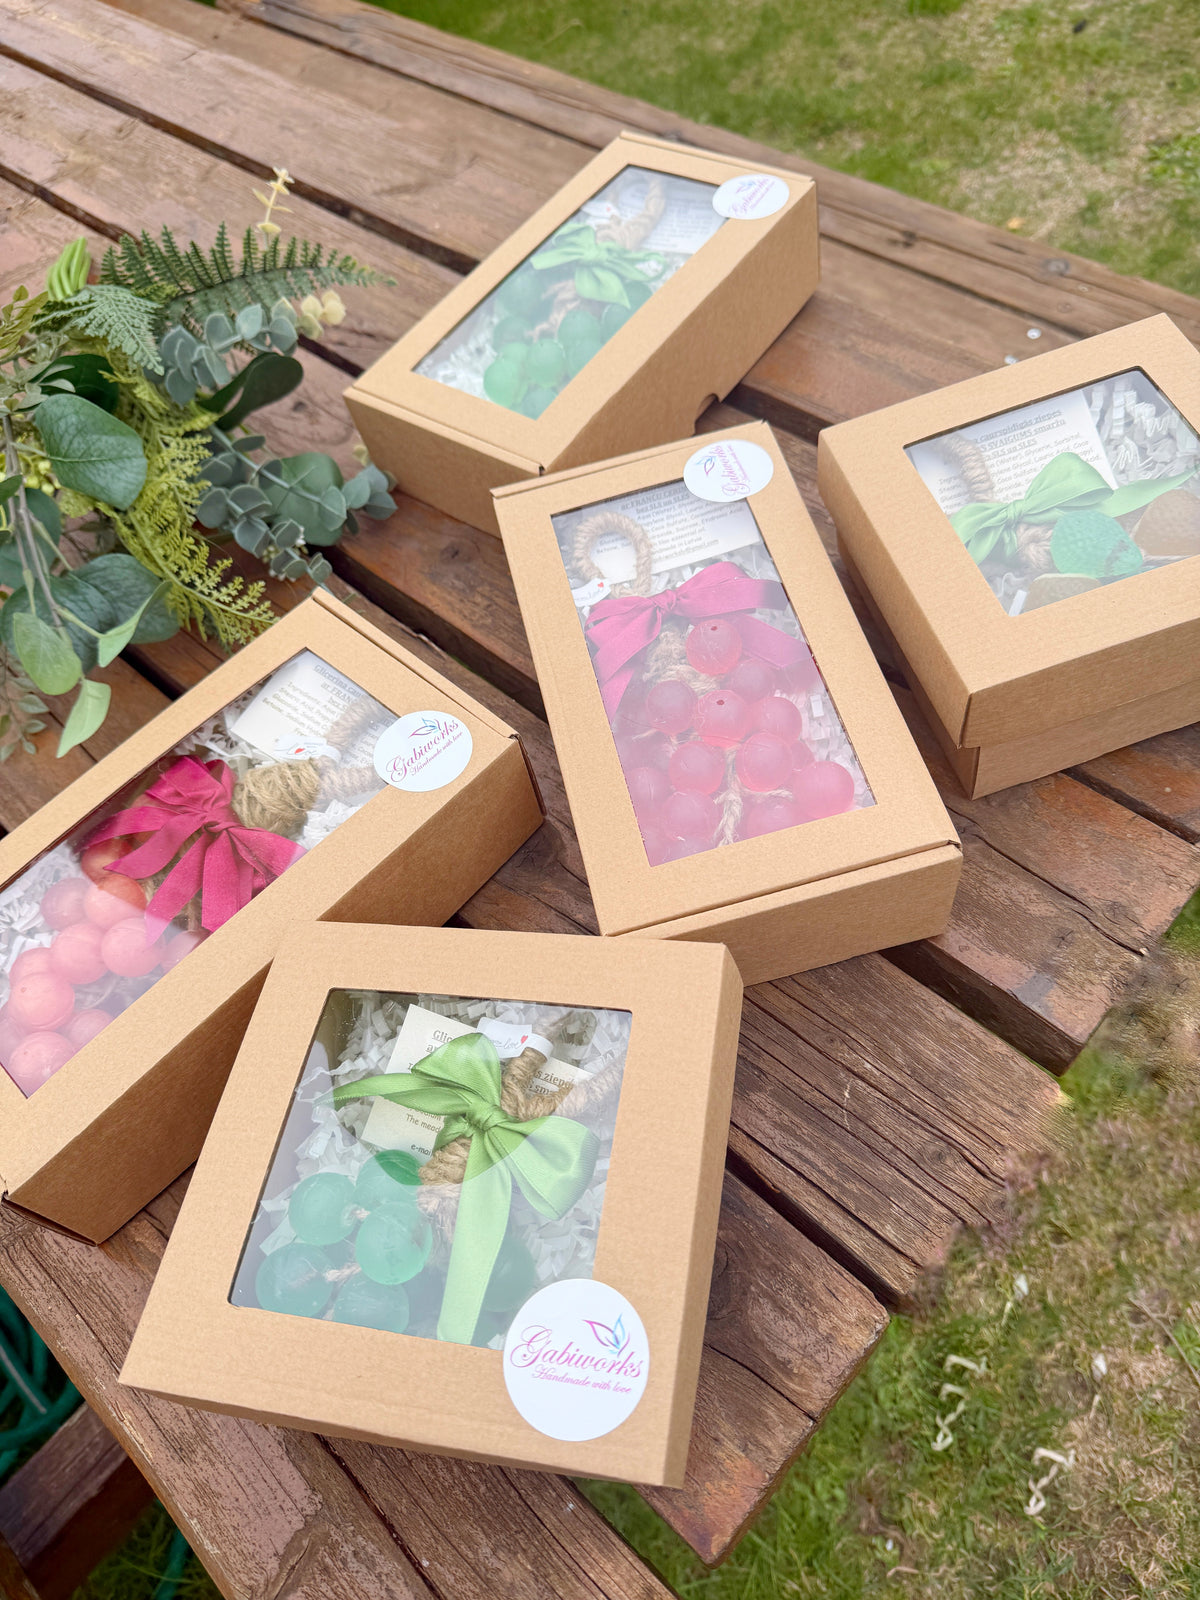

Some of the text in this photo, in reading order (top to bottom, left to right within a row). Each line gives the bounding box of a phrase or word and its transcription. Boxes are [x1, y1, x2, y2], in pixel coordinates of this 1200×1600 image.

[386, 720, 459, 782] Gabiworks
[406, 1113, 419, 1126] The
[420, 1121, 442, 1134] mead
[510, 1325, 643, 1378] Gabiworks
[532, 1364, 632, 1394] Handmade with love
